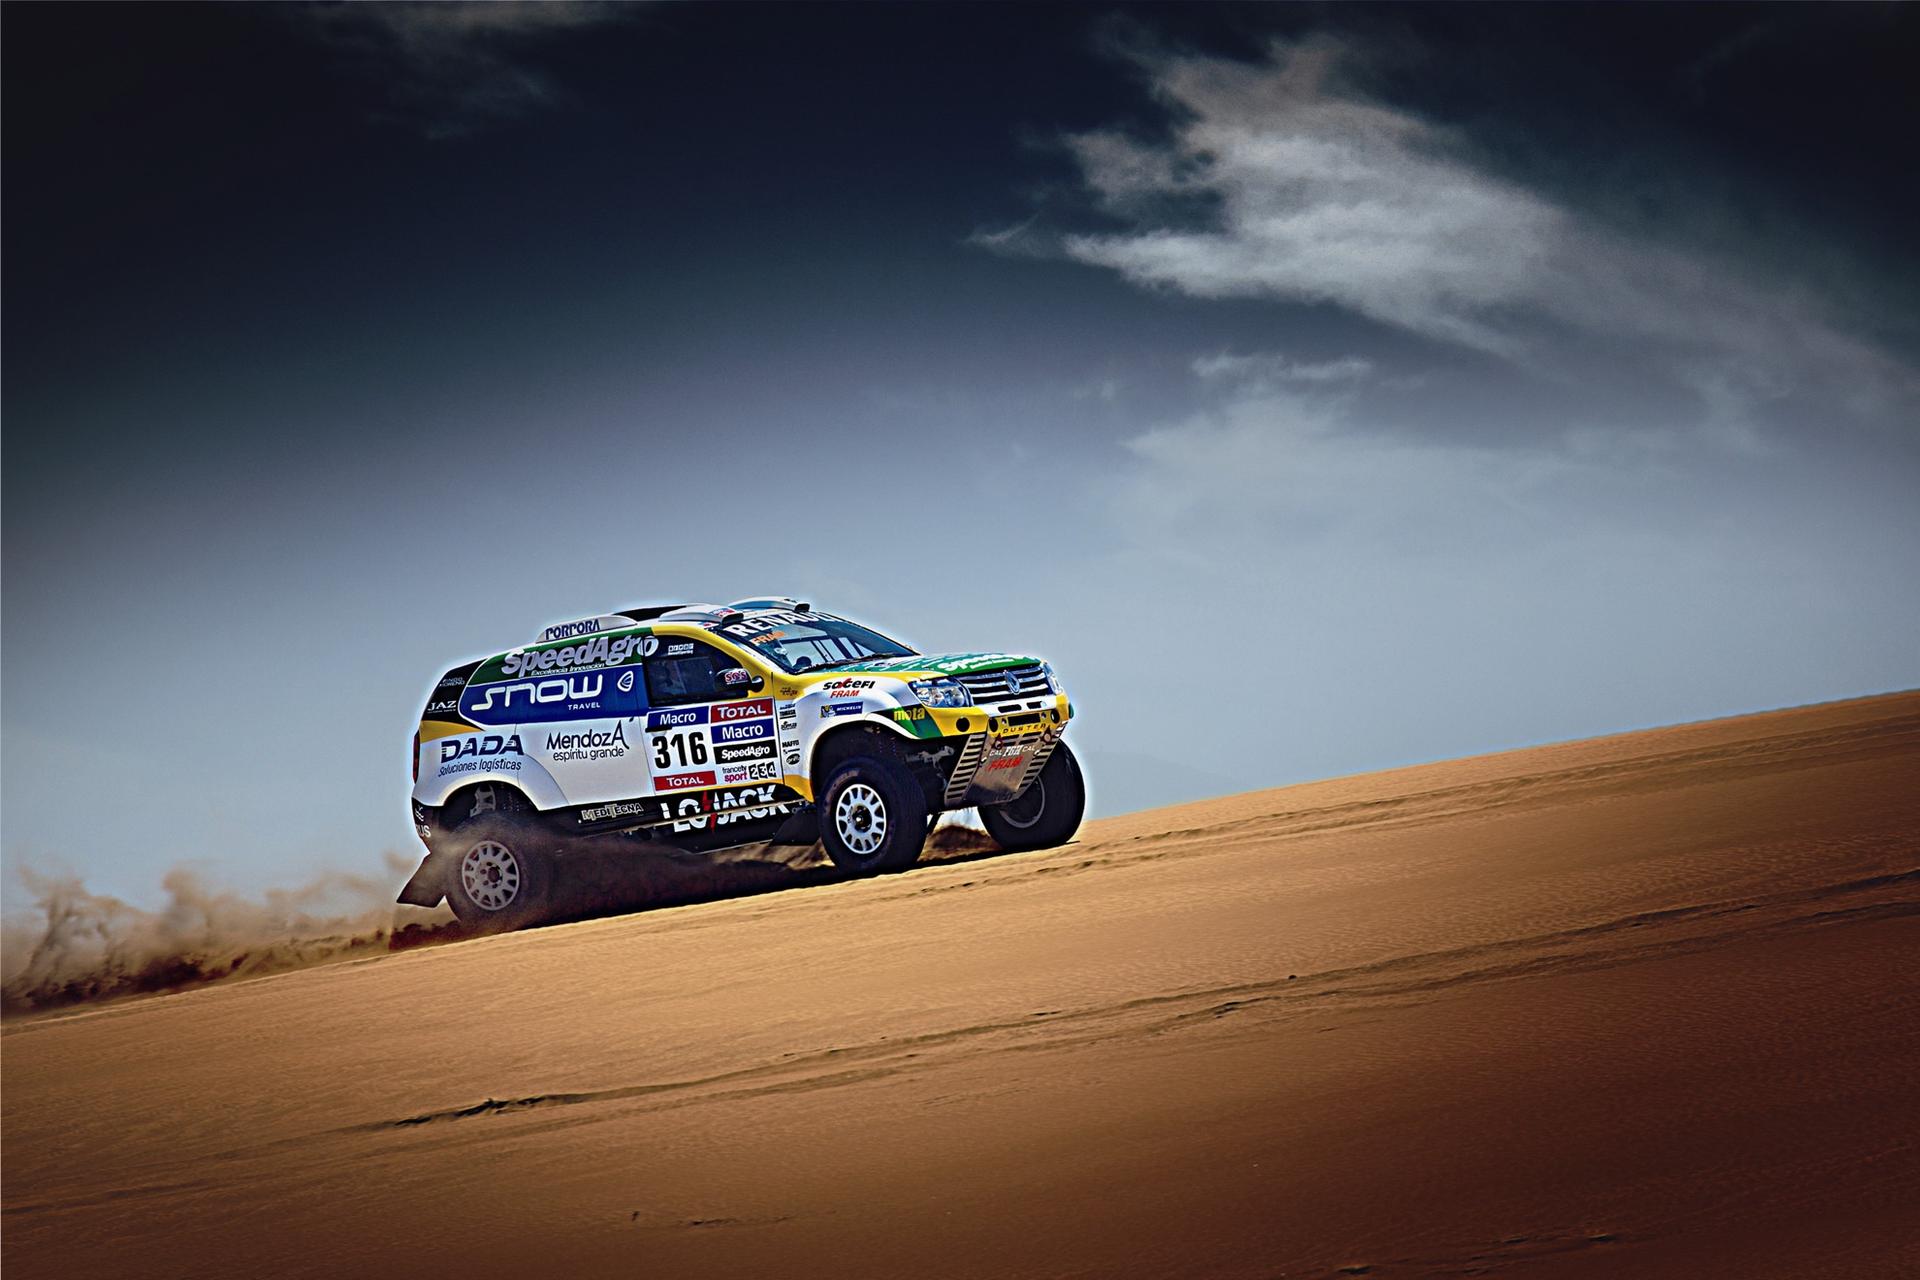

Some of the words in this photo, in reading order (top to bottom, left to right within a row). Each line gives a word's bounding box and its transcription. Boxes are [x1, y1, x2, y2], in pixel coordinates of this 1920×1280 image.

[545, 619, 601, 641] PORPORA
[501, 635, 660, 678] SpeedAgro
[829, 690, 861, 699] FRAM
[426, 700, 457, 712] JAZ
[567, 702, 601, 711] TRAVEL
[717, 704, 767, 719] TOTAL
[659, 712, 697, 726] Macro
[721, 724, 764, 740] Macro
[1002, 723, 1047, 734] DUSTER
[441, 735, 524, 764] DADA
[589, 747, 625, 761] grande
[652, 731, 709, 769] 316
[721, 745, 771, 761] SpeedAgro
[438, 761, 478, 777] Soluciones
[479, 758, 522, 772] logísticas
[666, 776, 705, 787] TOTAL
[724, 771, 748, 783] sport
